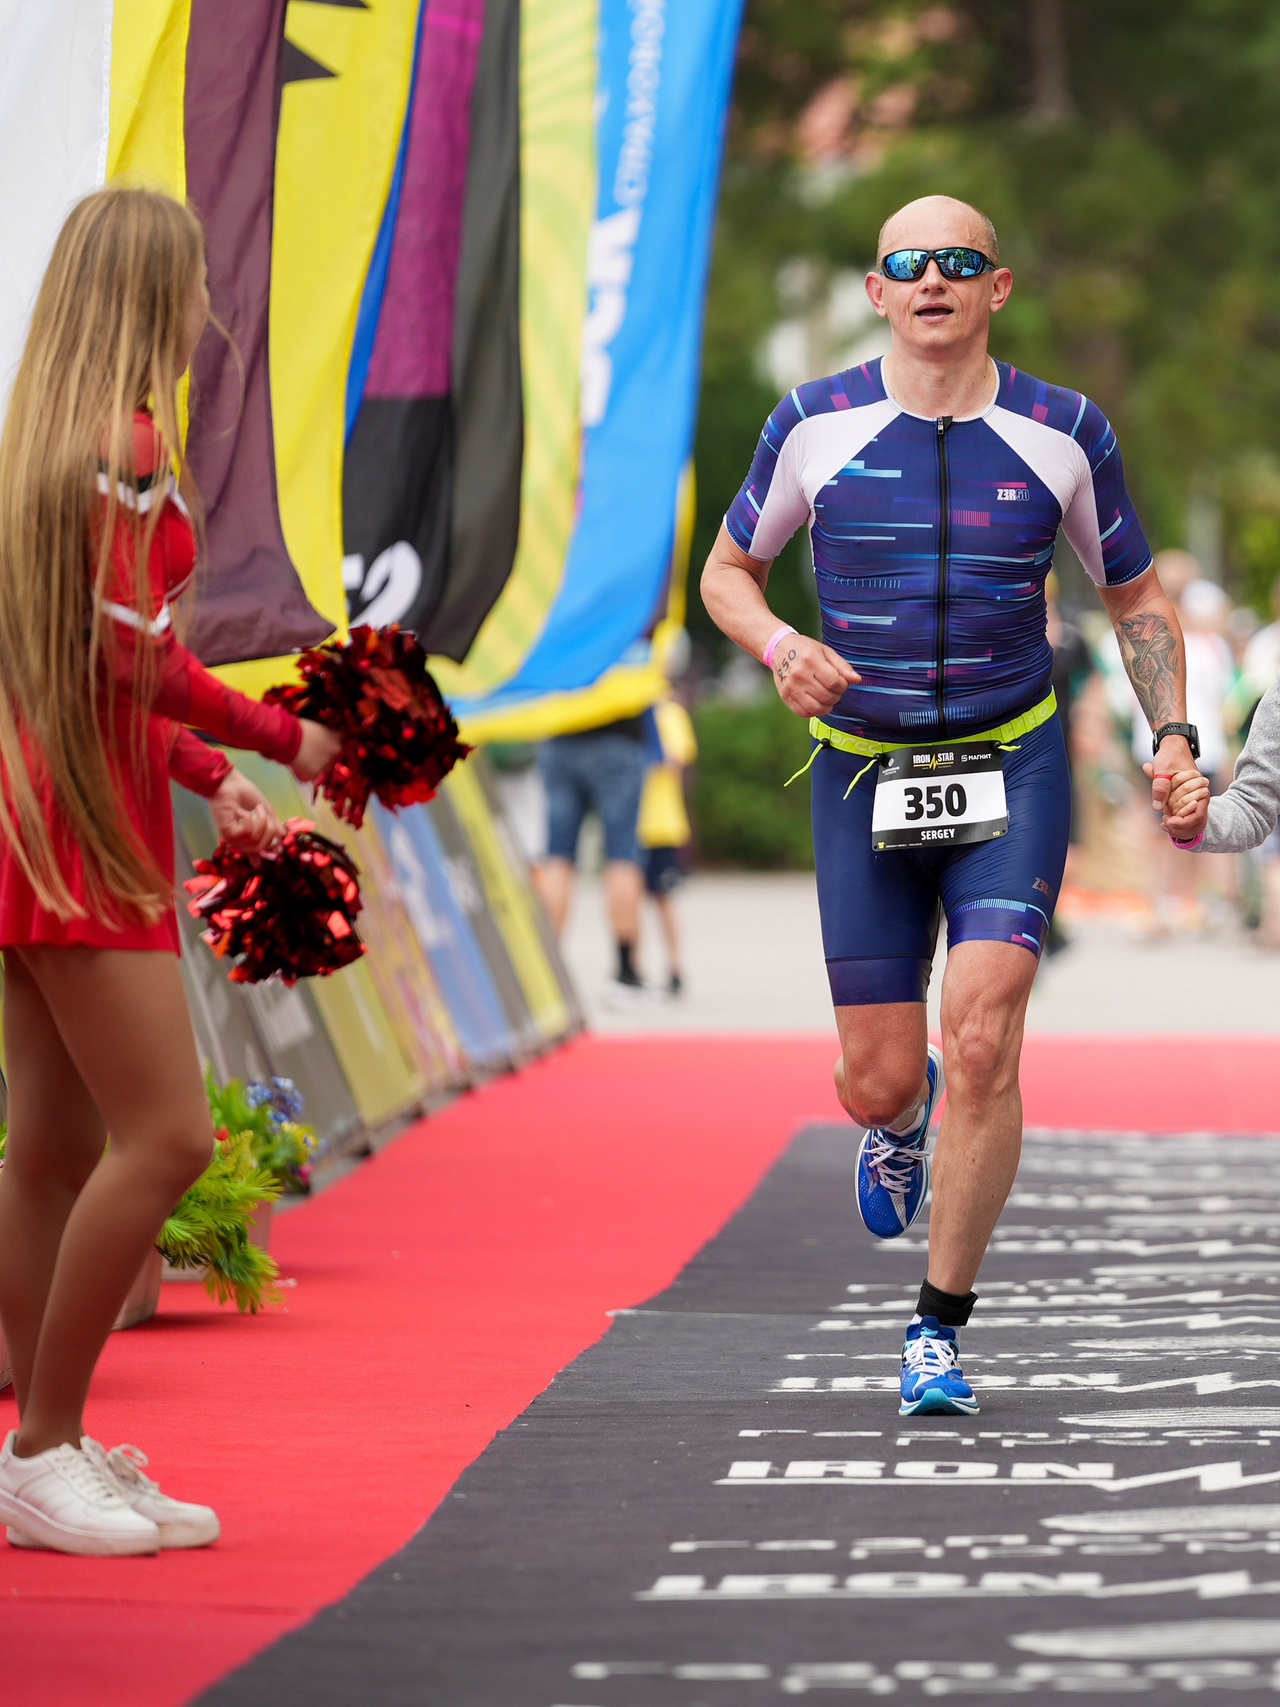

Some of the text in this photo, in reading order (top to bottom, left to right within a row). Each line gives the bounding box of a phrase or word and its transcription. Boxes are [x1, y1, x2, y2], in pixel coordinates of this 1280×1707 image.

[912, 752, 955, 764] IRON STAR
[968, 753, 992, 761] МАГНИТ
[904, 783, 967, 820] 350
[920, 828, 956, 841] SERGEY
[728, 1460, 1116, 1478] IRON
[651, 1571, 1106, 1596] IRON
